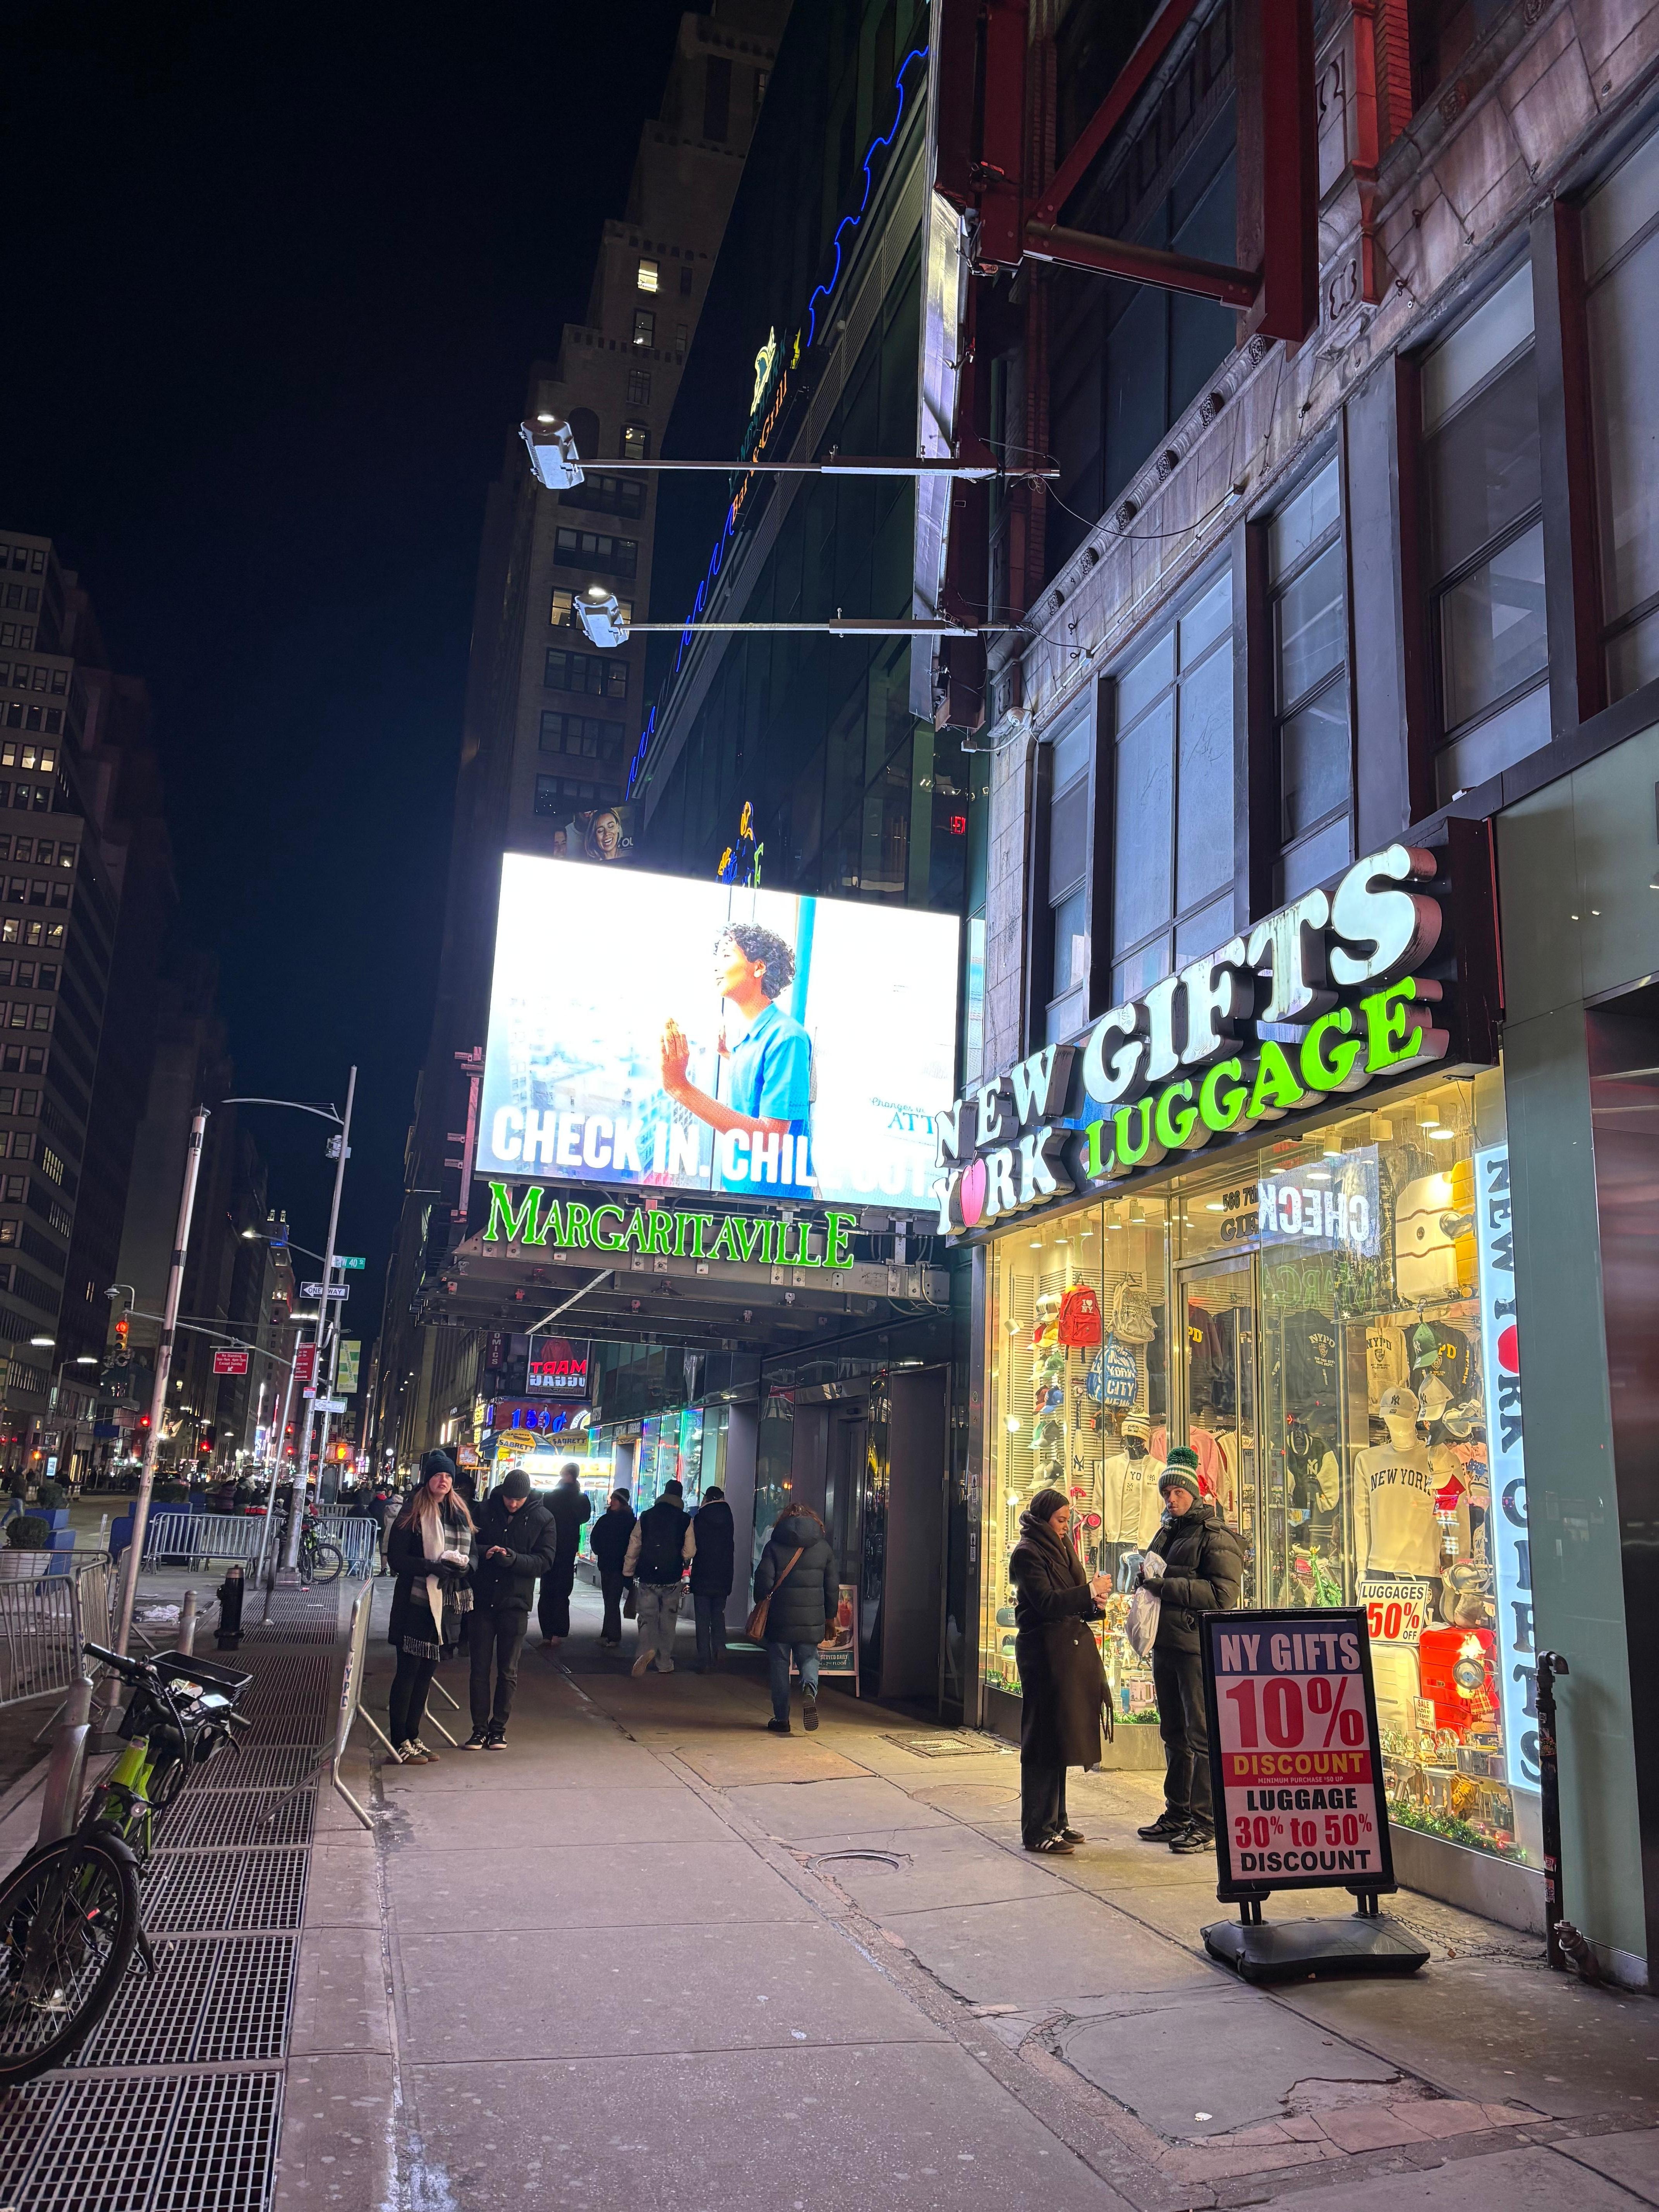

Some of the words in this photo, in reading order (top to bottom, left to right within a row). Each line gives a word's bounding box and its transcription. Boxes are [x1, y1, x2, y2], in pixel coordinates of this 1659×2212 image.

[761, 369, 787, 449] Grill
[1083, 843, 1417, 1103] GIFTS
[1085, 975, 1423, 1180] LUGGAGE
[935, 1044, 1057, 1168] NEW
[491, 1106, 644, 1173] CHECK
[652, 1121, 710, 1178] IN.
[1222, 1190, 1240, 1212] 566
[483, 1180, 857, 1270] MARGARITAVILLE
[342, 1257, 348, 1267] W
[349, 1258, 357, 1267] 40
[1309, 1333, 1336, 1348] NYPD
[1367, 1337, 1392, 1351] NYPD
[1107, 1380, 1135, 1397] CITY
[1391, 1394, 1400, 1405] NY
[500, 1439, 534, 1451] SABRETT
[1073, 1455, 1085, 1472] NY
[1371, 1468, 1398, 1493] NEW
[1401, 1468, 1431, 1496] YORK
[1362, 1585, 1424, 1600] LUGGAGES
[1368, 1602, 1420, 1639] 50%
[1403, 1630, 1417, 1640] OFF
[1220, 1634, 1261, 1672] NY
[1270, 1632, 1360, 1671] GIFTS
[1226, 1676, 1364, 1748] 10%
[1418, 1699, 1429, 1709] SALE
[1233, 1753, 1364, 1775] DISCOUNT
[1247, 1788, 1358, 1811] LUGGAGE
[1235, 1815, 1284, 1848] 30%
[1290, 1818, 1317, 1847] to
[1324, 1814, 1372, 1846] 50%
[1240, 1850, 1371, 1872] DISCOUNT
